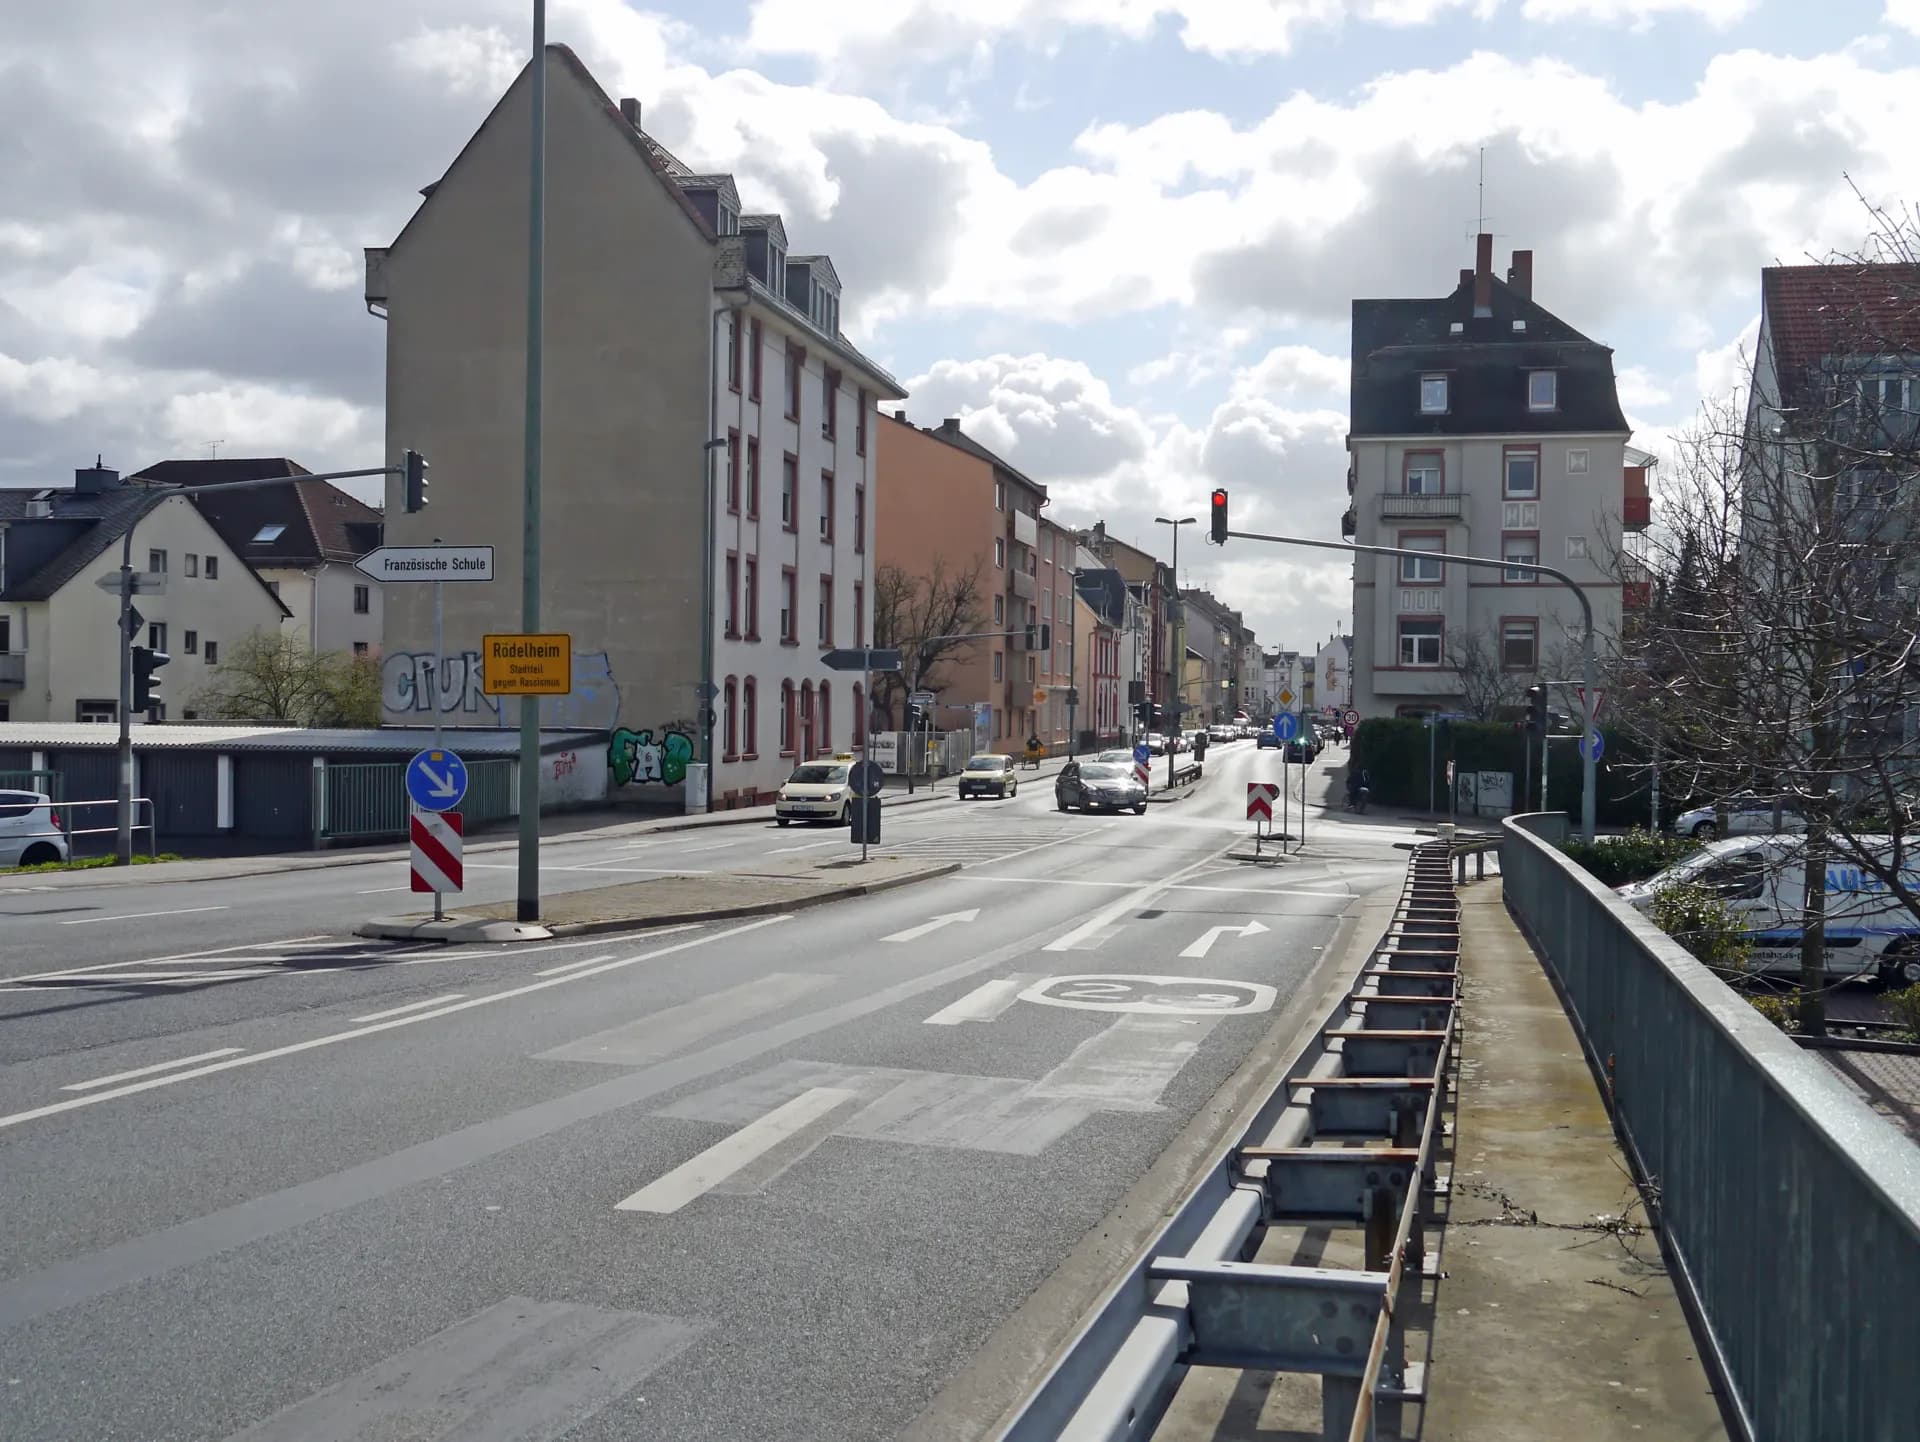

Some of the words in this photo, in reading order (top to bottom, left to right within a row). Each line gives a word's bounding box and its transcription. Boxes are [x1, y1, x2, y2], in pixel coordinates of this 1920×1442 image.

[384, 557, 448, 572] Französische
[452, 557, 486, 571] Schule
[493, 642, 560, 658] Rödelheim
[510, 663, 544, 674] Stadtteil
